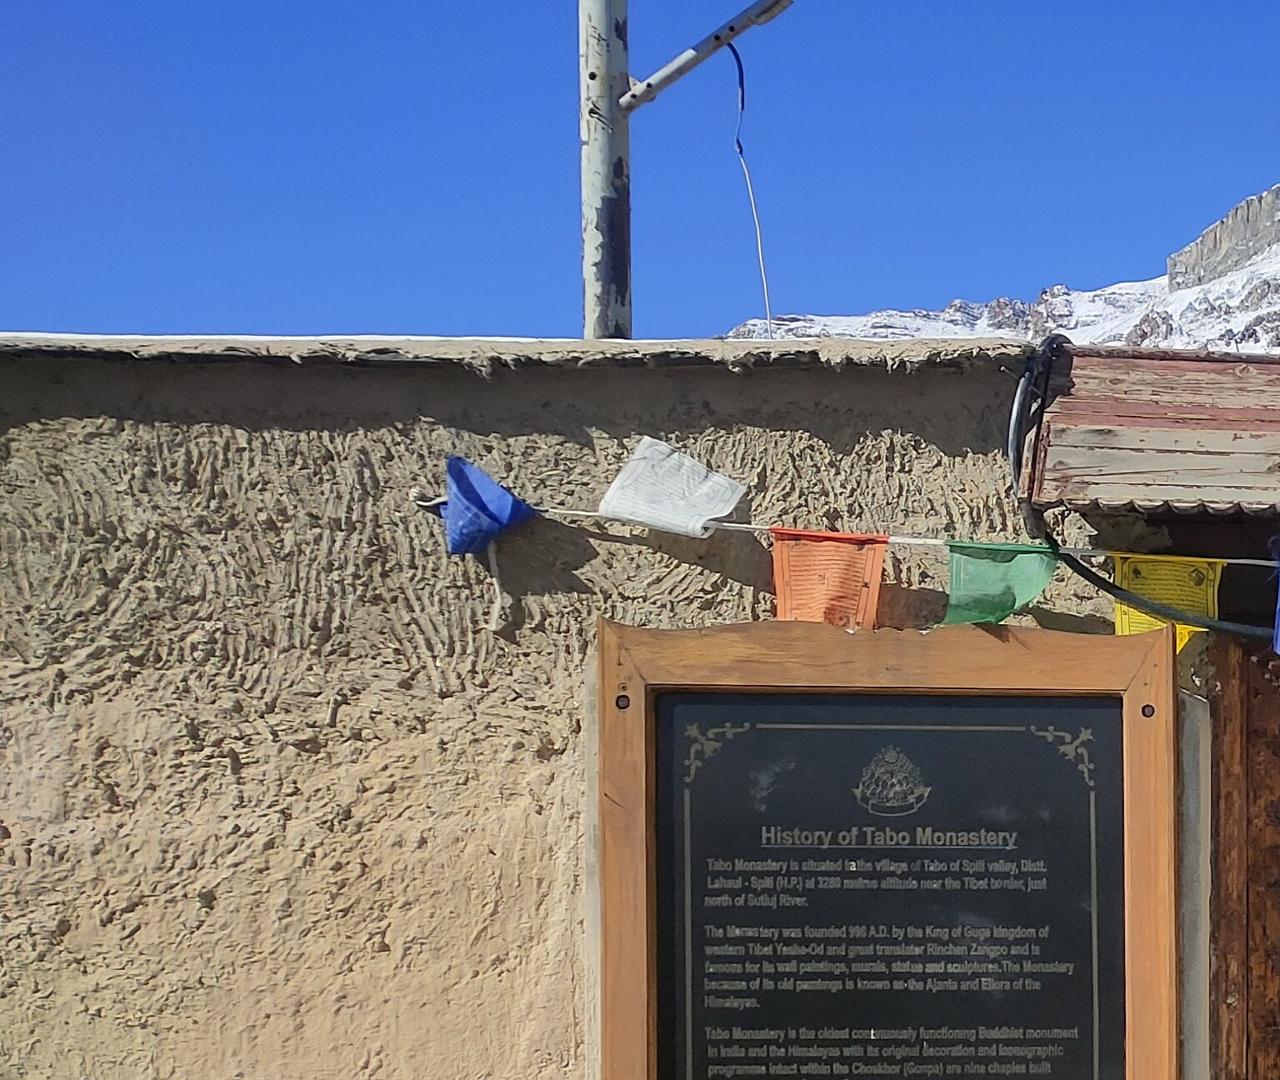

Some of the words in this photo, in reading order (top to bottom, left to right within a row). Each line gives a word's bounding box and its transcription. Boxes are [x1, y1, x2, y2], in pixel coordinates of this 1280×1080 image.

[761, 827, 832, 849] History
[837, 827, 859, 845] of
[862, 827, 911, 845] Tabo
[915, 827, 1018, 849] Monastery
[707, 858, 733, 871] Tabo
[734, 858, 788, 874] Monastery
[801, 858, 843, 871] situated
[874, 859, 909, 874] village
[923, 859, 948, 872] Tabo
[949, 859, 961, 872] of
[987, 859, 1019, 875] valley,
[706, 876, 743, 889] Lahaul
[944, 878, 962, 890] the
[963, 878, 989, 890] Tibet
[1027, 878, 1048, 893] just
[703, 894, 733, 907] north
[734, 894, 746, 907] of
[778, 894, 809, 907] River.
[704, 926, 724, 938] The
[726, 926, 780, 941] Monastery
[804, 925, 847, 938] founded
[868, 925, 890, 937] A.D.
[891, 924, 906, 940] by
[906, 924, 924, 937] the
[951, 924, 962, 937] of
[963, 924, 991, 940] Guge
[992, 924, 1037, 940] kingdom
[1038, 924, 1050, 937] of
[747, 944, 774, 956] Tibet
[826, 944, 846, 956] and
[926, 943, 968, 956] Rinchen
[969, 943, 1008, 958] Zangpo
[1010, 942, 1030, 955] and
[744, 960, 761, 973] for
[924, 961, 945, 974] and
[1022, 960, 1075, 976] Monastery
[749, 978, 761, 990] of
[856, 978, 891, 991] known
[907, 978, 925, 991] the
[925, 978, 959, 994] Ajanta
[959, 978, 980, 991] and
[1012, 978, 1024, 990] of
[1024, 978, 1042, 990] the
[704, 1026, 731, 1039] Tabo
[731, 1026, 786, 1042] Monastery
[798, 1026, 816, 1039] the
[1025, 1026, 1079, 1039] monument
[747, 1046, 768, 1058] and
[769, 1046, 786, 1058] the
[832, 1062, 850, 1075] the
[903, 1062, 944, 1078] (Gonpa)
[1028, 1062, 1052, 1075] built
